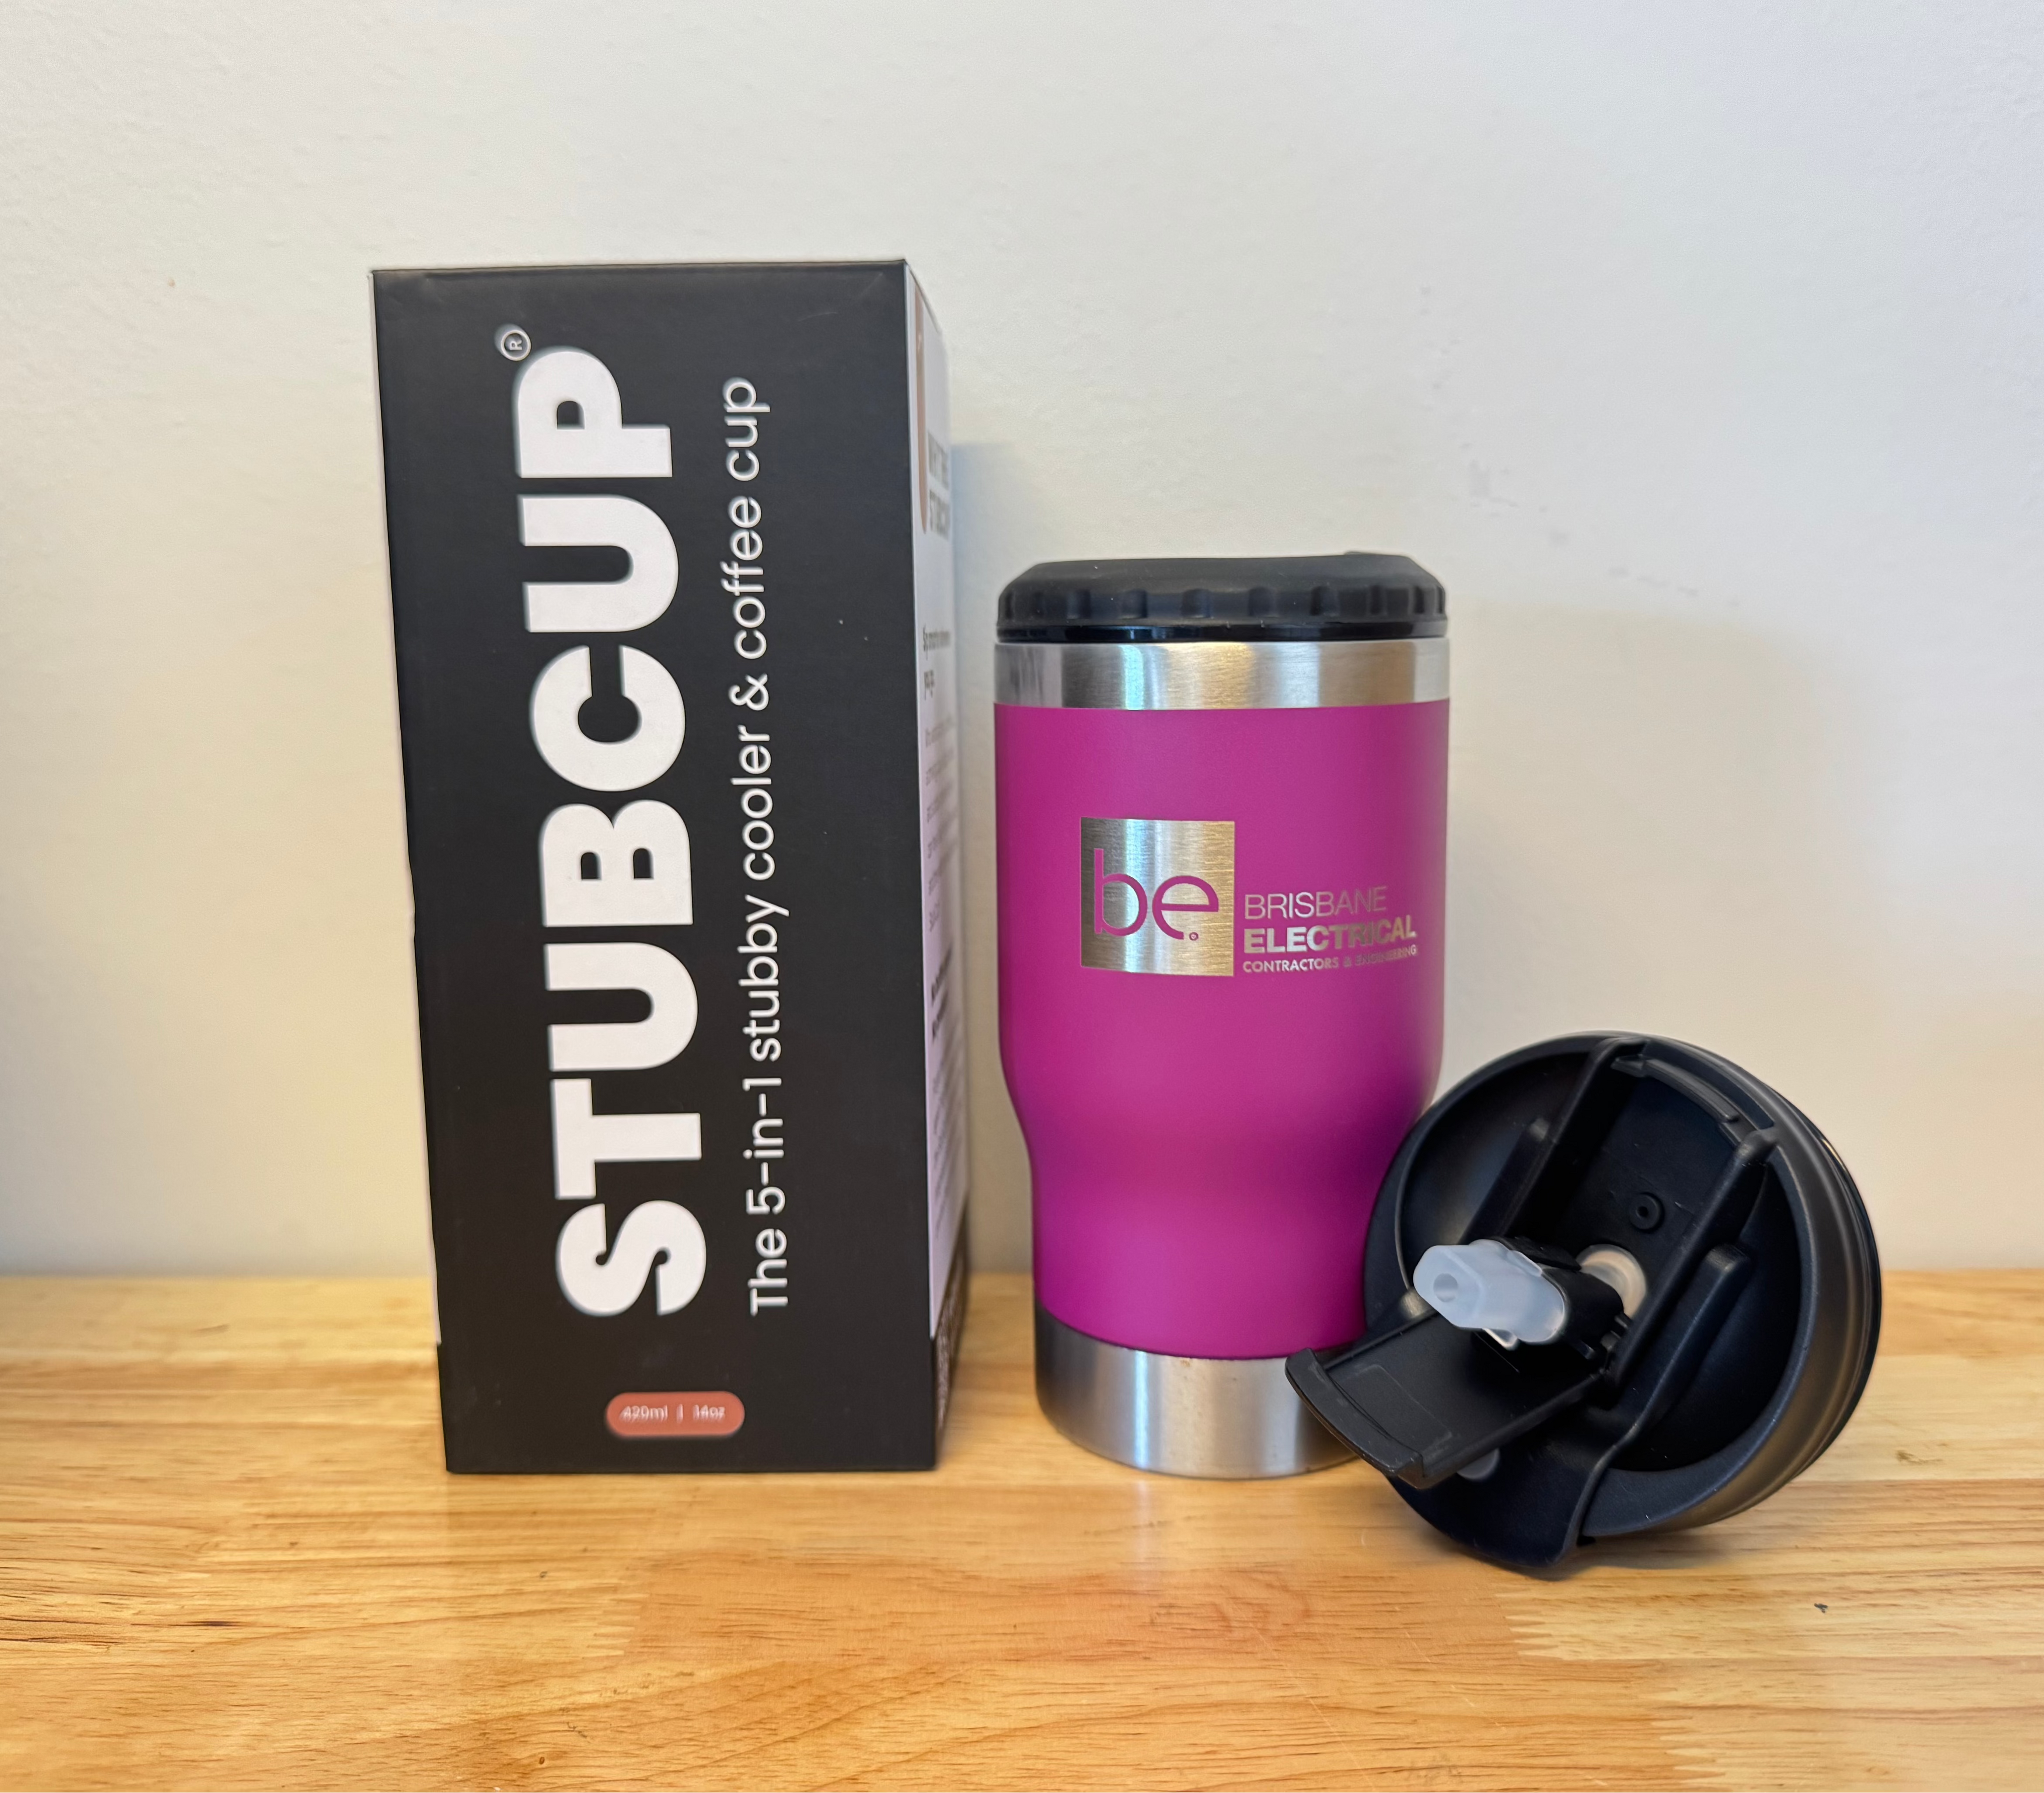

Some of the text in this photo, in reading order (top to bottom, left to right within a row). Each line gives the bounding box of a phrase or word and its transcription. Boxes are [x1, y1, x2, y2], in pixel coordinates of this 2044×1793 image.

[720, 378, 790, 1316] The 5-in-1 stubby cooler & coffee cup
[1244, 886, 1387, 920] BRISBANE
[1243, 915, 1417, 954] ELECTRICAL
[1242, 957, 1339, 973] CONTRACTORS
